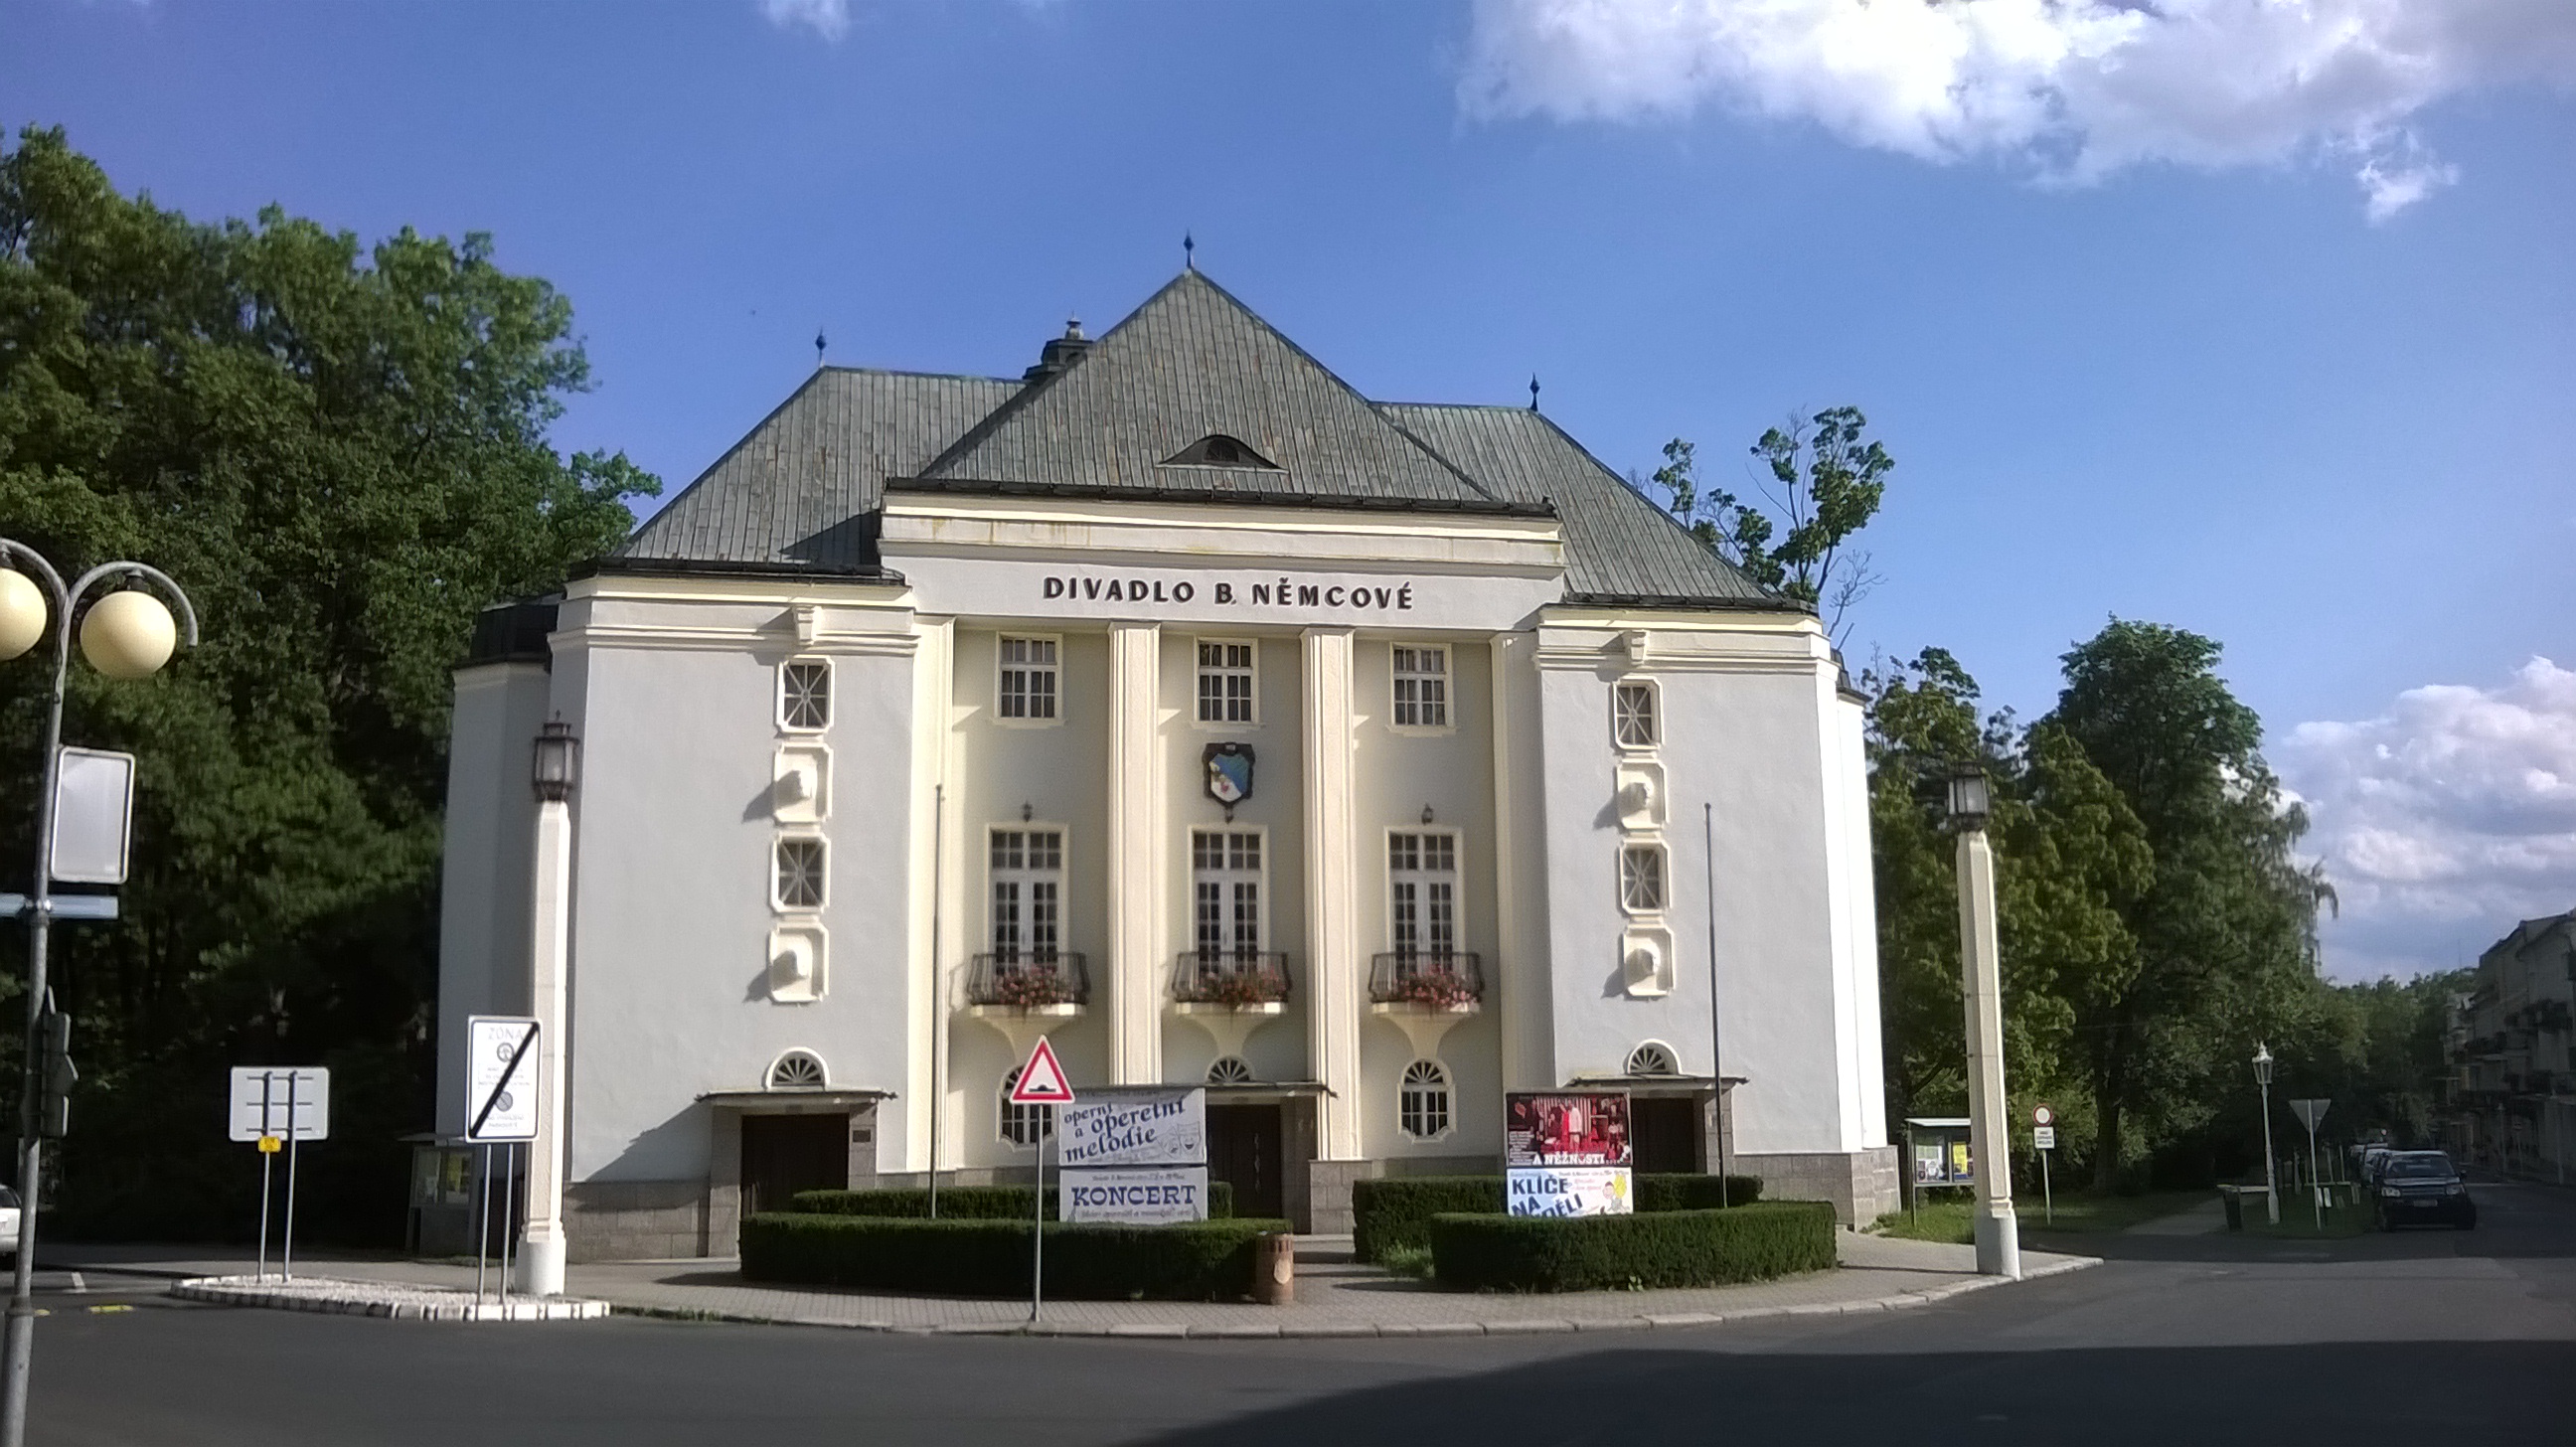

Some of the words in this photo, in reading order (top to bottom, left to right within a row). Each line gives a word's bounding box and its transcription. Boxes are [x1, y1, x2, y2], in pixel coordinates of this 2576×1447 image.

[1043, 576, 1195, 603] DIVADLO
[1213, 582, 1237, 605] B.
[1251, 577, 1413, 609] NĚMCOVÉ
[1074, 1127, 1083, 1139] a
[1064, 1125, 1157, 1163] melodie
[1531, 1153, 1542, 1165] A
[1071, 1185, 1197, 1206] KONCERT
[1512, 1174, 1569, 1196] KLÍČE
